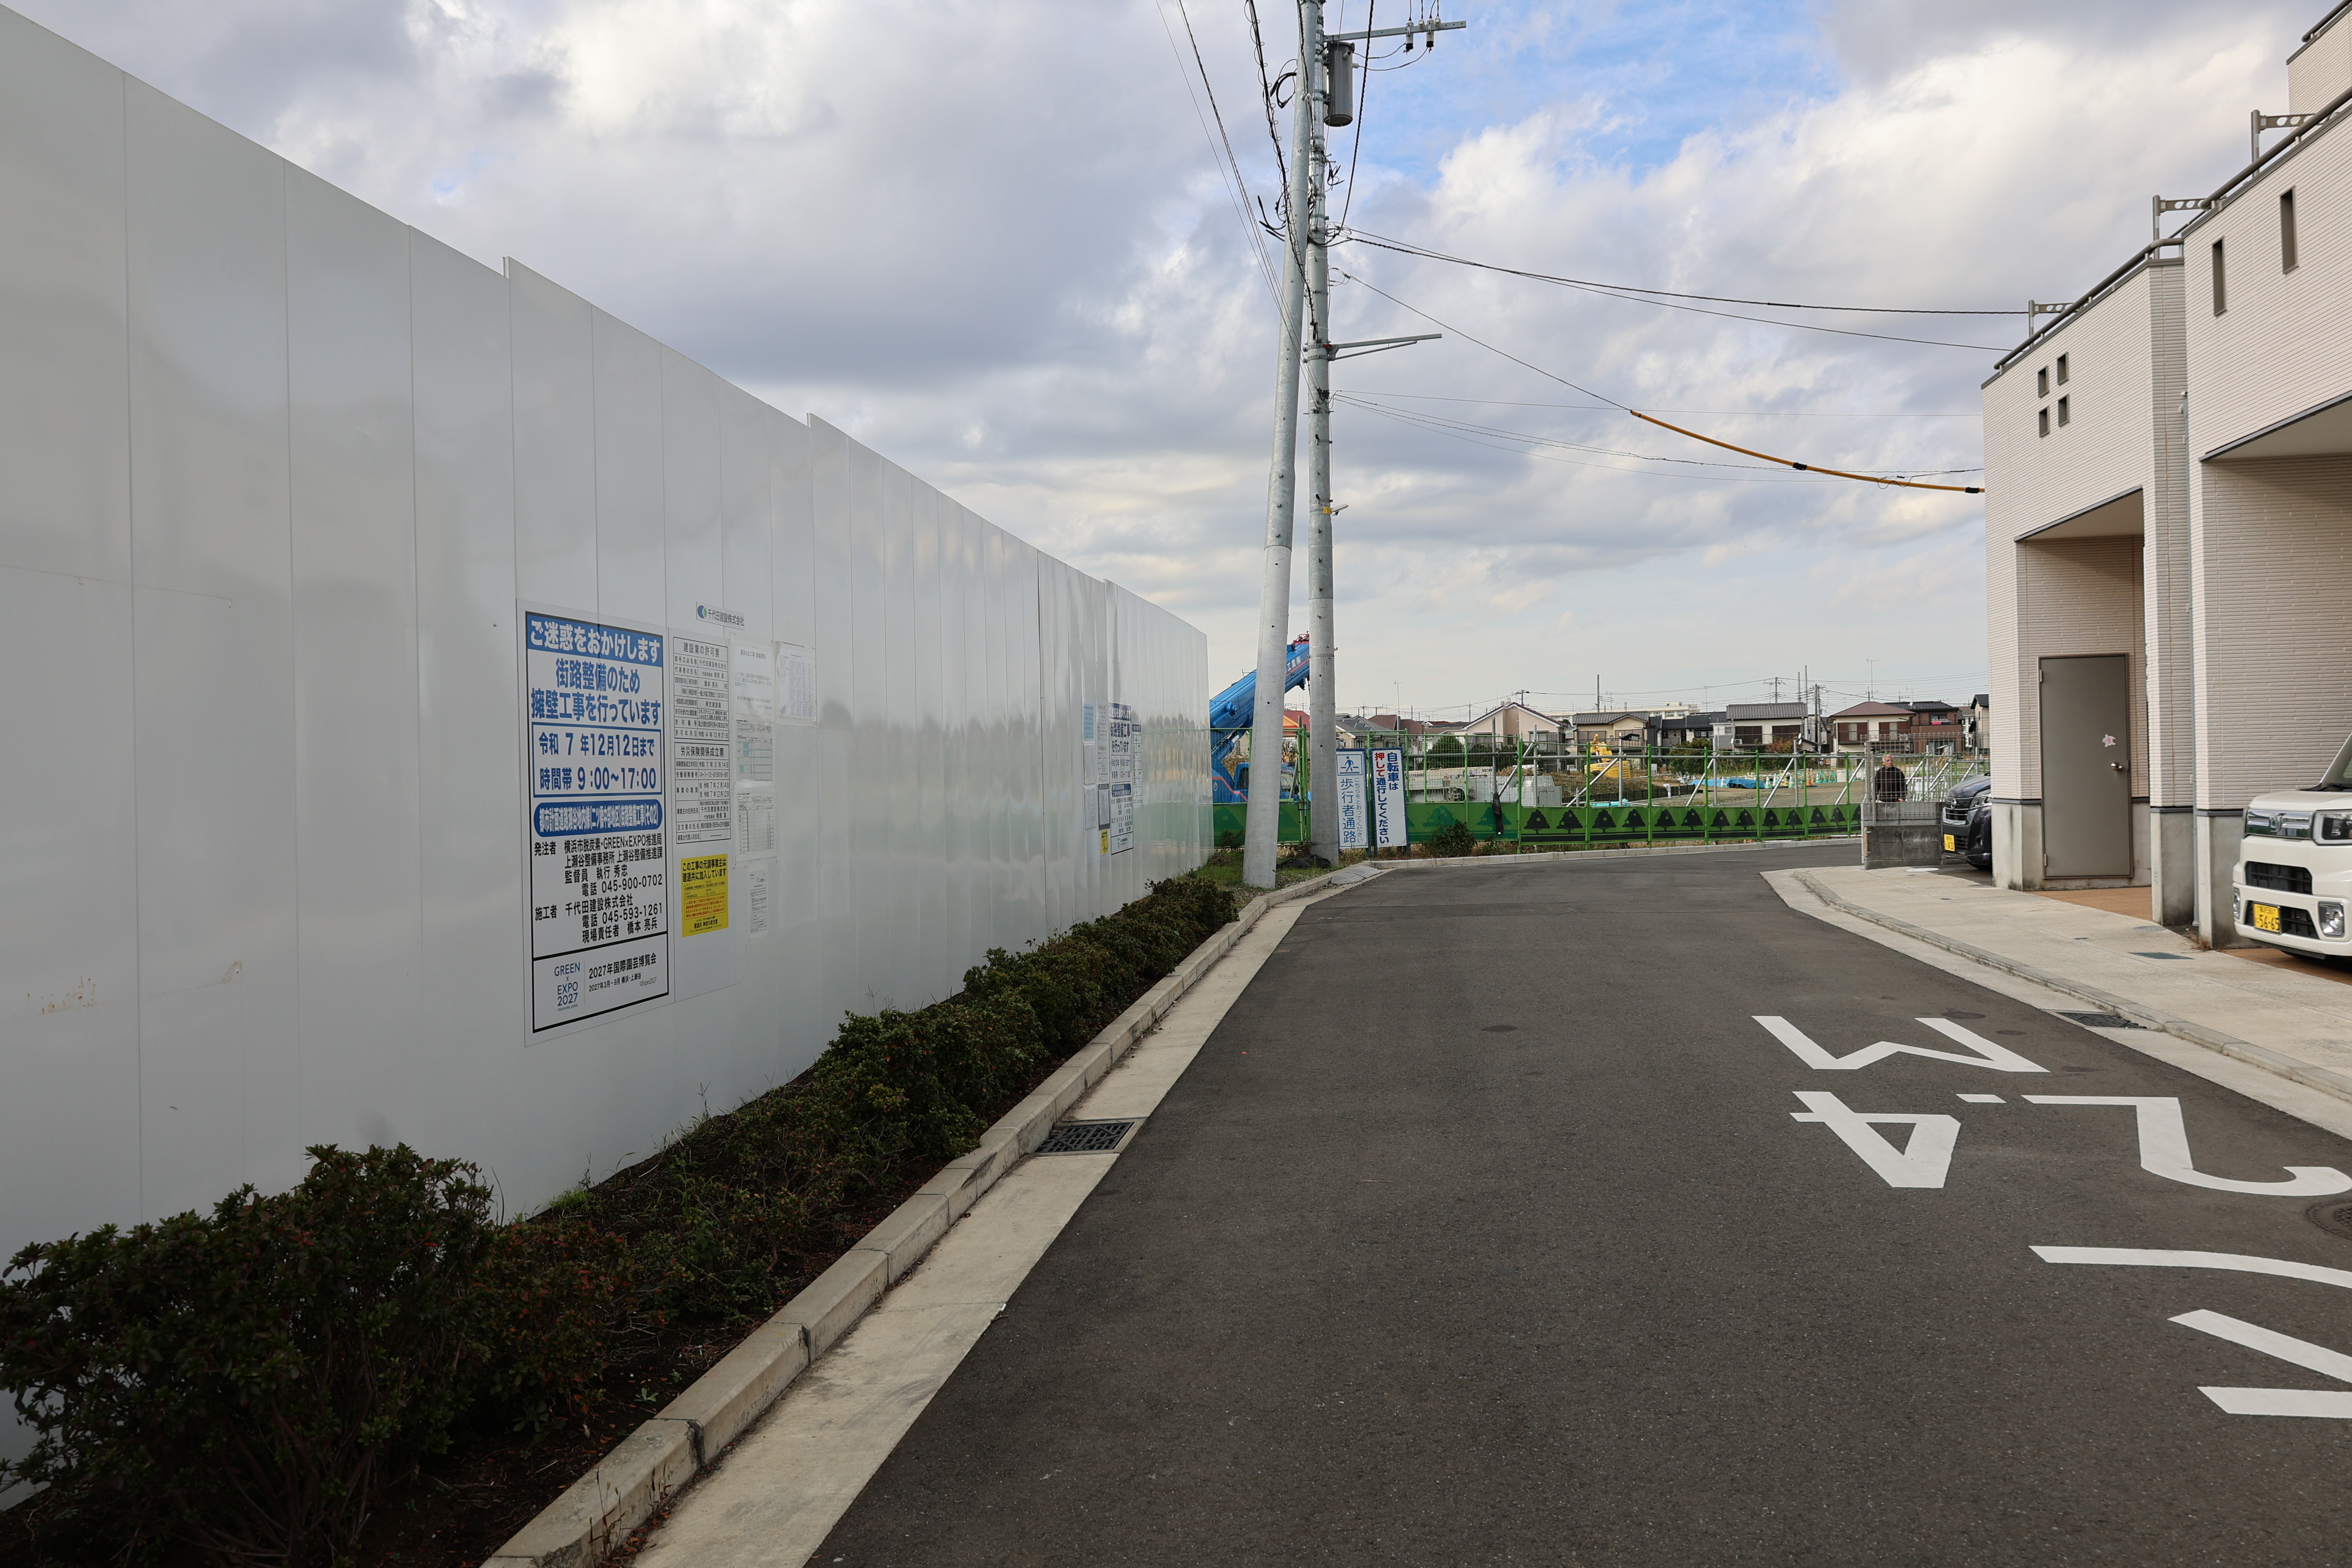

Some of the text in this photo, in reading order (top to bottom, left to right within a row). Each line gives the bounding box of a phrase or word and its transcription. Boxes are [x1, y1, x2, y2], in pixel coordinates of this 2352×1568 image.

[708, 609, 744, 626] 千代田建設株式会社
[531, 620, 660, 663] ご迷惑をおかけします
[683, 642, 720, 658] 建設業の許可票
[674, 655, 697, 665] 商号又は名称
[675, 666, 697, 675] 代表者の氏名
[699, 659, 726, 669] 千代田建設株式会社
[556, 658, 640, 694] 街路整備のため
[531, 688, 661, 726] 擁壁工事を行っています
[680, 746, 724, 757] 労災保険関係成立票
[540, 767, 572, 790] 時間帯
[1387, 752, 1400, 790] 自転車は
[1375, 753, 1389, 844] 押して通行してください
[1341, 778, 1356, 843] 歩行者通路
[1354, 778, 1363, 842] こちらをとおってください
[534, 841, 556, 856] 発注者
[565, 847, 663, 869] 上瀬谷整備事務所 上瀬谷整備推進課
[565, 869, 588, 884] 監督員
[614, 864, 628, 878] 秀忠
[683, 858, 726, 871] この工事の元請事業主は
[683, 868, 726, 882] 建退共に加入しています
[582, 874, 662, 896] 電話 045-900-0702
[535, 893, 633, 921] 施工者 千代田建設株式会社
[582, 903, 662, 928] 電話 045-593-1261
[582, 917, 657, 943] 現場責任者 橋本 亮兵
[554, 962, 580, 976] GREEN
[589, 953, 656, 979] 2027年国際園芸博覧会
[557, 982, 578, 995] EXPO
[557, 993, 578, 1006] 2027
